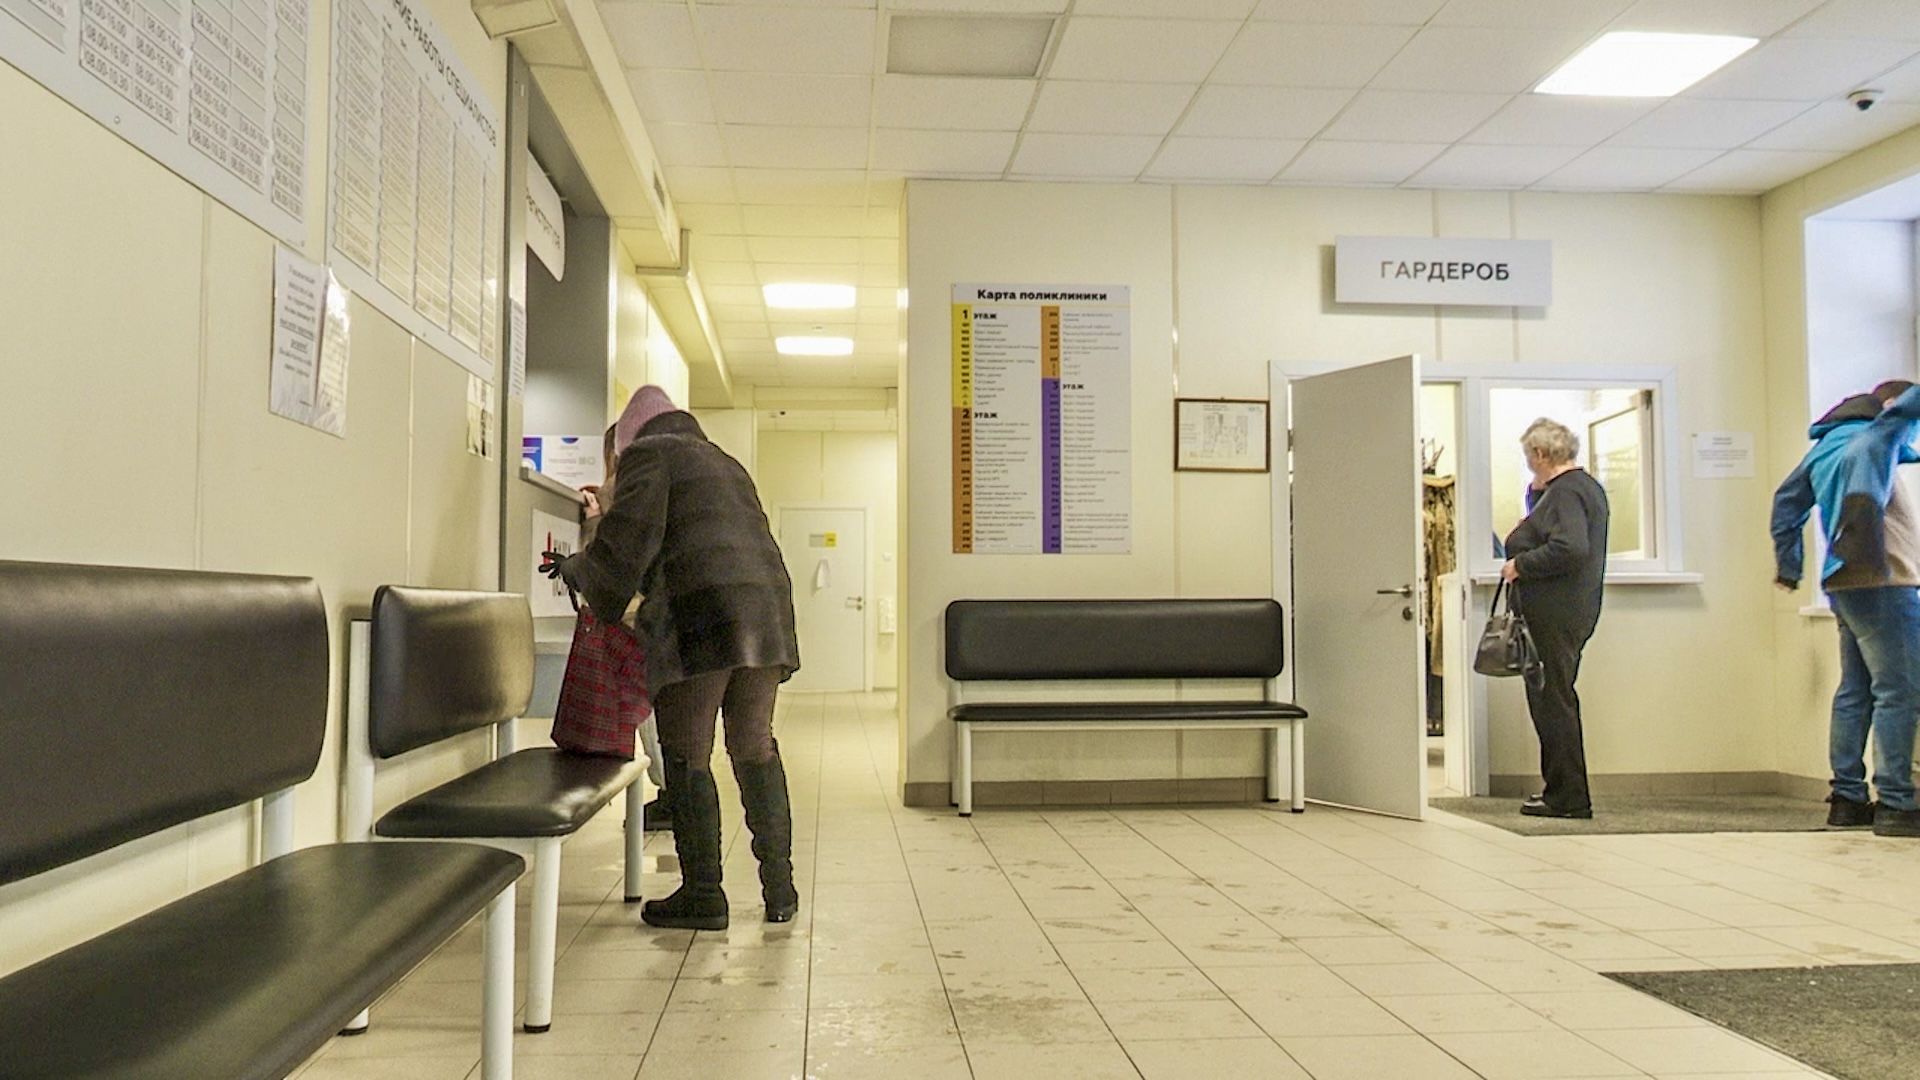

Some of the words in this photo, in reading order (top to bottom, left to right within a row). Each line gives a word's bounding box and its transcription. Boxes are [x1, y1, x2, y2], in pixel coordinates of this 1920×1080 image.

[413, 17, 446, 76] РАБОТЫ
[1380, 260, 1509, 282] ГАРДЕРОБ
[977, 289, 1016, 301] Карта
[1020, 290, 1107, 301] поликлиники
[962, 309, 969, 320] 1
[974, 312, 997, 320] этаж
[962, 409, 970, 419] 2
[974, 411, 998, 419] этаж
